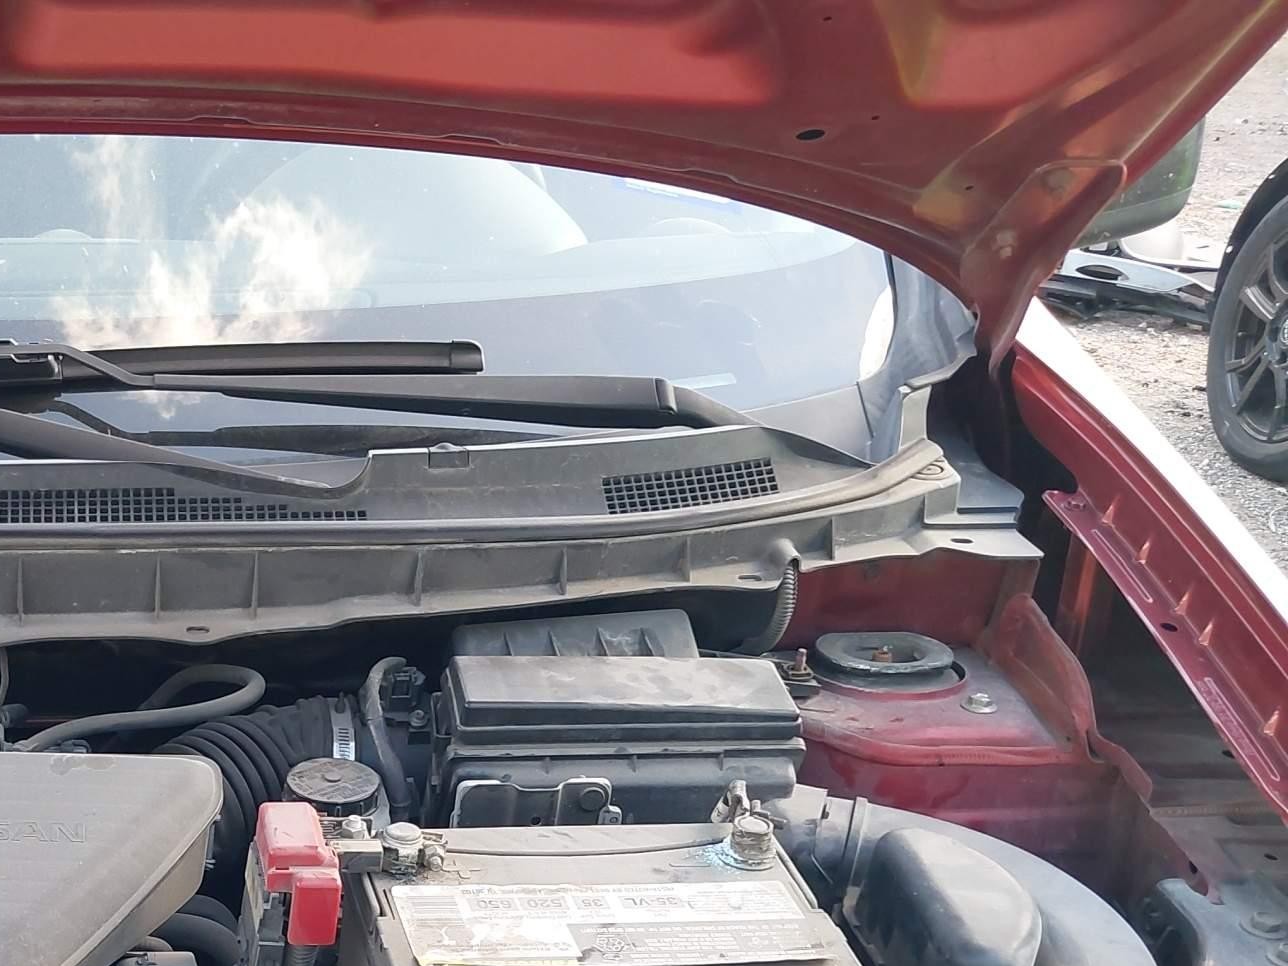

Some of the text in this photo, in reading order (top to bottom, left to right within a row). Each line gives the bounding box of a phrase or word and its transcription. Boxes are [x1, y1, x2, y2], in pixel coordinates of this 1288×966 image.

[477, 899, 512, 909] 650
[527, 898, 562, 908] 520
[582, 898, 603, 907] 35
